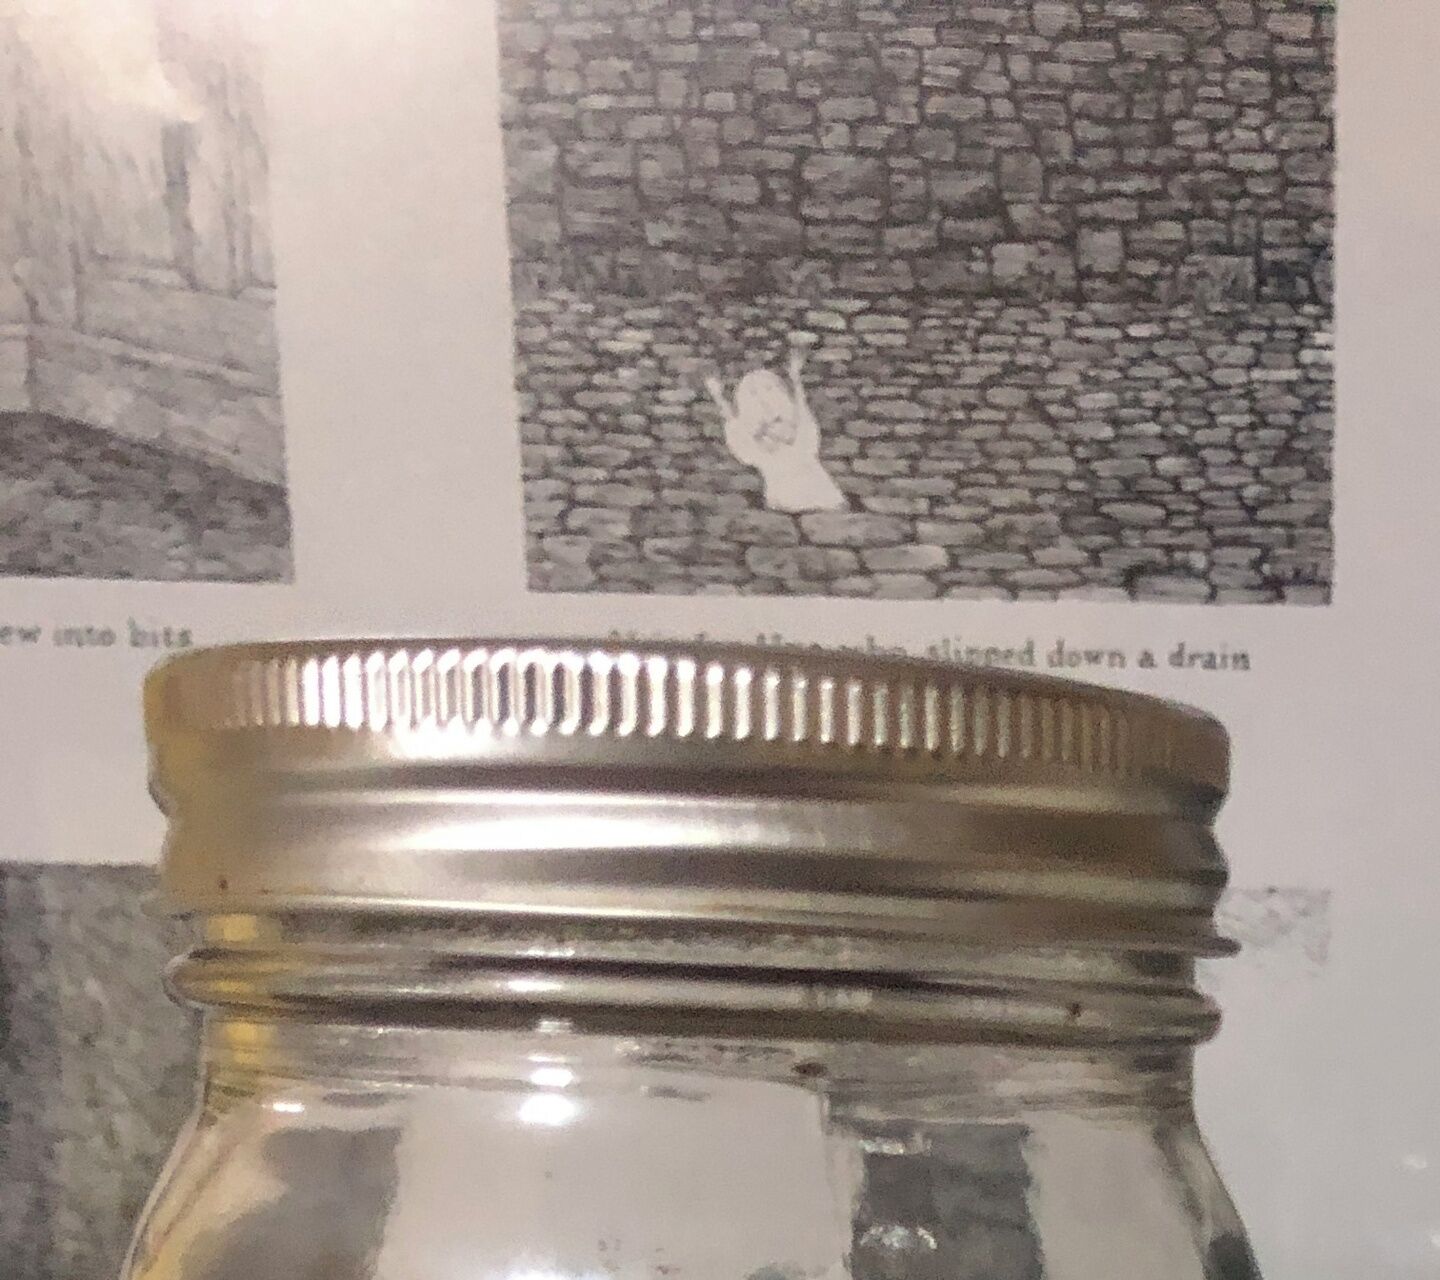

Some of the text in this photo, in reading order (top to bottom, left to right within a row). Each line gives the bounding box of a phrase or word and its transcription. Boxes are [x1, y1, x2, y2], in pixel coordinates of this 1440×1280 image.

[53, 626, 117, 647] into
[127, 616, 193, 648] bits
[1047, 638, 1127, 669] down
[1137, 649, 1157, 670] a
[1168, 641, 1251, 671] drain
